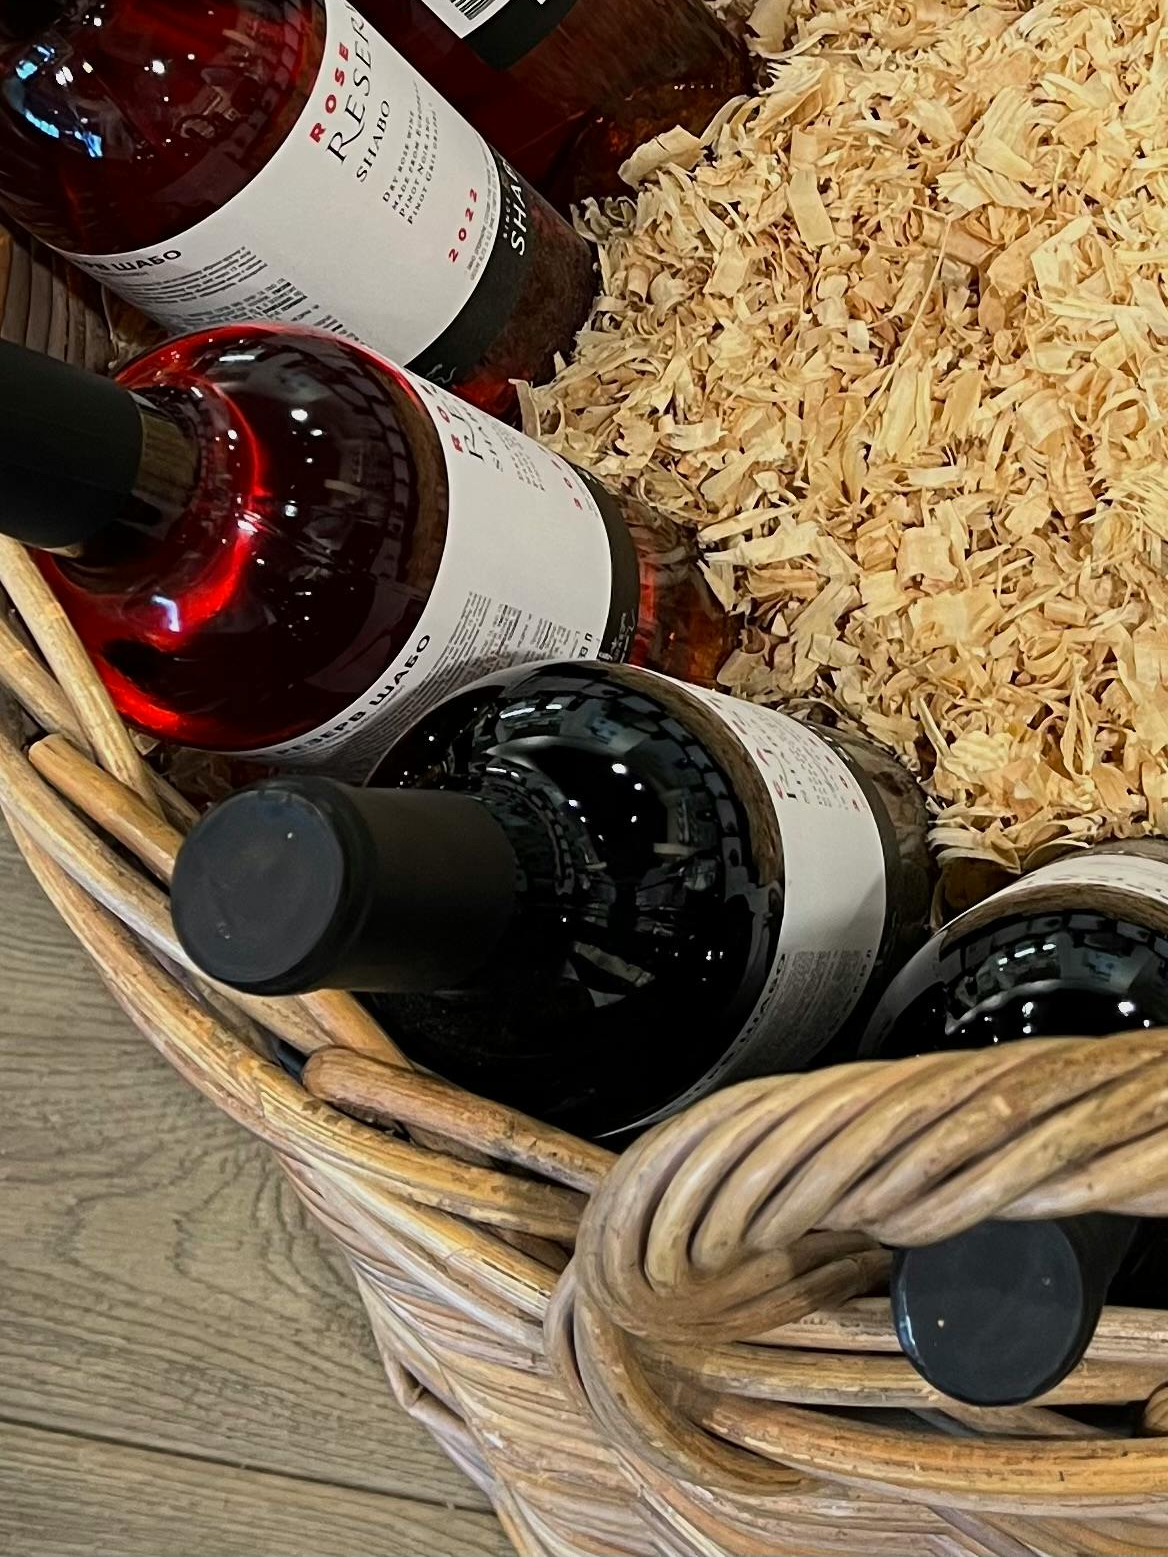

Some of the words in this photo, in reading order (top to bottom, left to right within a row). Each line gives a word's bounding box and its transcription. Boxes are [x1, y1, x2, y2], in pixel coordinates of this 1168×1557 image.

[310, 42, 349, 143] ROSE
[326, 3, 372, 165] RESER
[356, 100, 390, 183] SHABO
[383, 176, 398, 202] DRY
[392, 176, 410, 210] MADE
[399, 178, 419, 217] PINOT
[407, 186, 428, 225] PINOT
[503, 161, 527, 255] SHA
[111, 249, 182, 272] ШАБО
[449, 189, 477, 262] 2022
[369, 635, 430, 706] ШАБО
